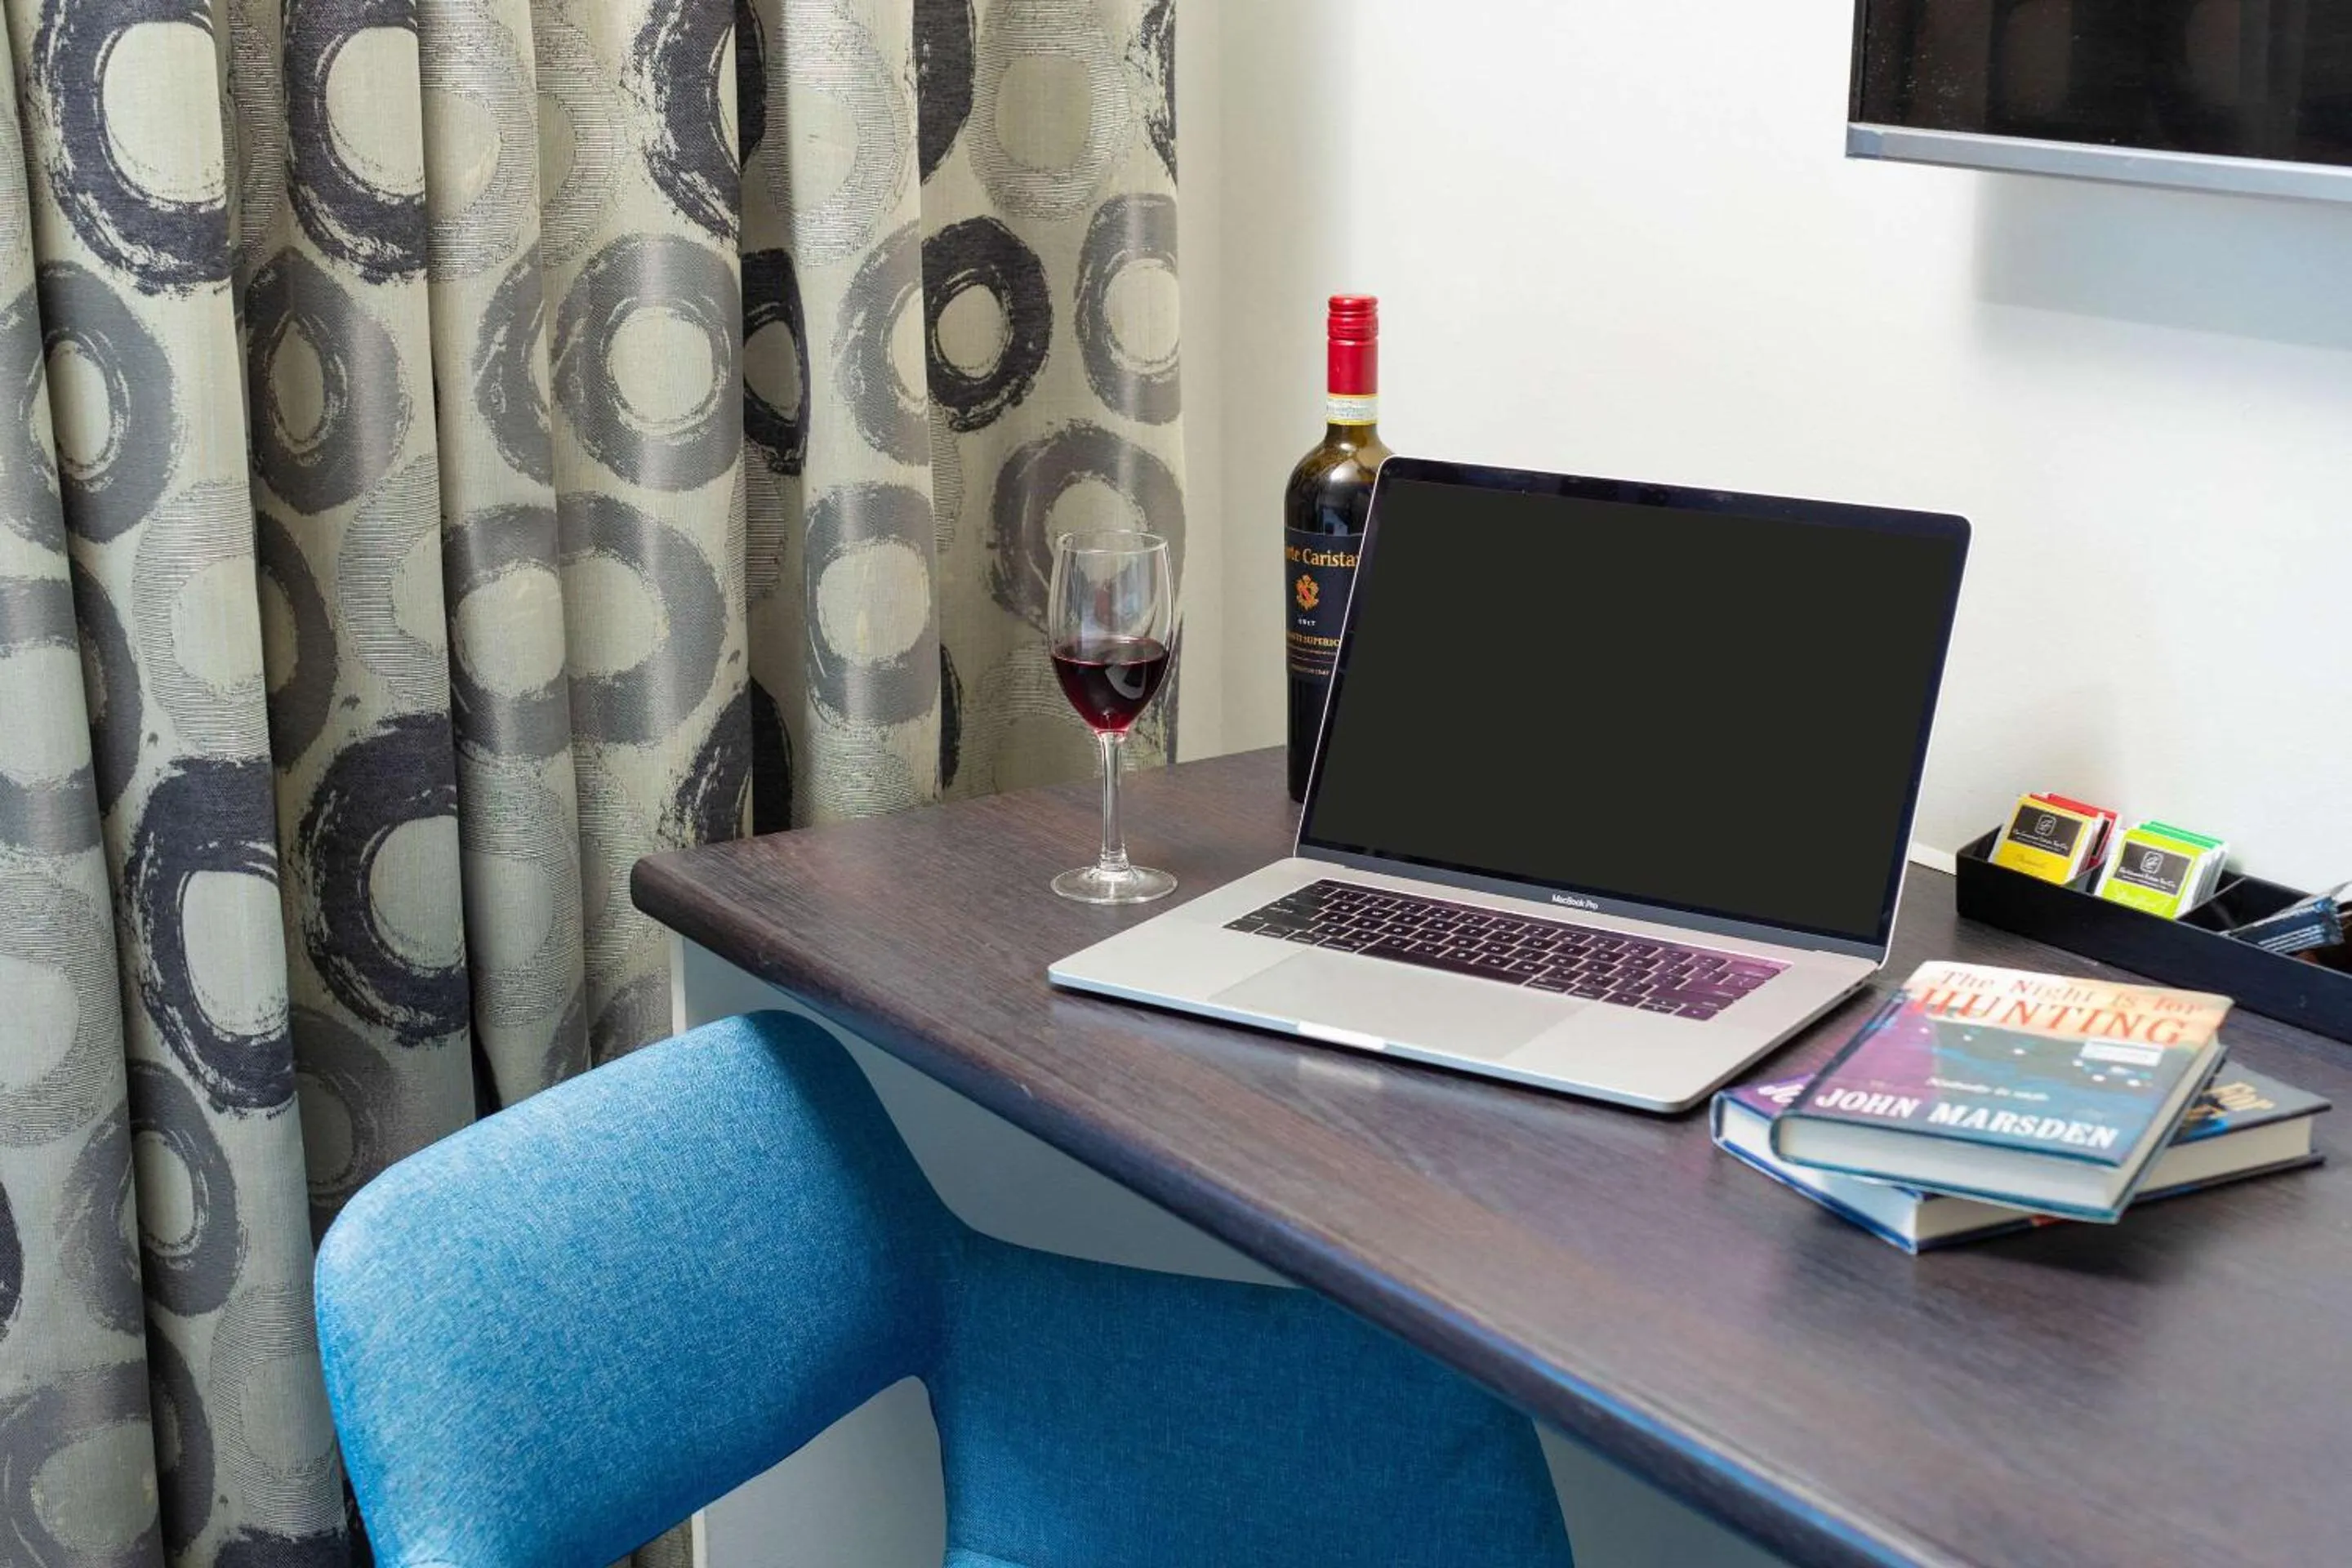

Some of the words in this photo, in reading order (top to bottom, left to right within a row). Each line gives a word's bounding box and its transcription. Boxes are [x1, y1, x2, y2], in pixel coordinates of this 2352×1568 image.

[1302, 548, 1359, 567] Carista
[1552, 893, 1585, 908] MacBook
[1585, 899, 1598, 910] Pro
[1941, 970, 1995, 989] The
[2009, 979, 2098, 1004] Night
[1911, 987, 2187, 1046] HUNTING
[1815, 1088, 1922, 1120] JOHN
[1927, 1102, 2119, 1151] MARSDEN
